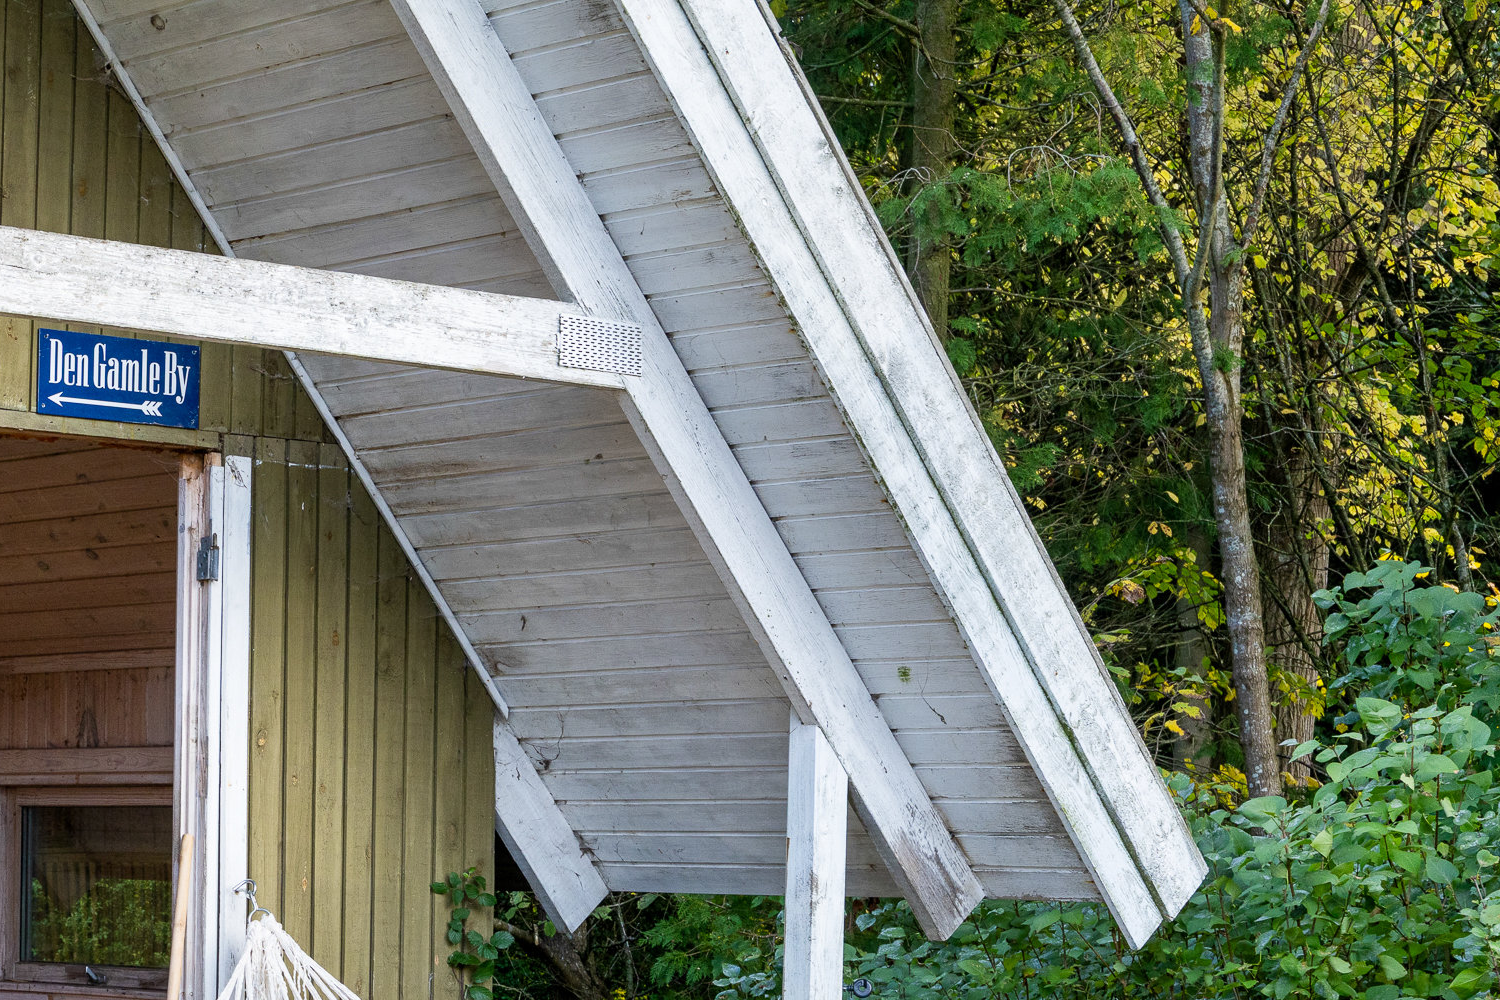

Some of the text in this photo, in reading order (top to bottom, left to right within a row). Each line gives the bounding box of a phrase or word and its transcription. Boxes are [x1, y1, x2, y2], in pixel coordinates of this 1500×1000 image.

[49, 338, 191, 405] Den Gamle By
